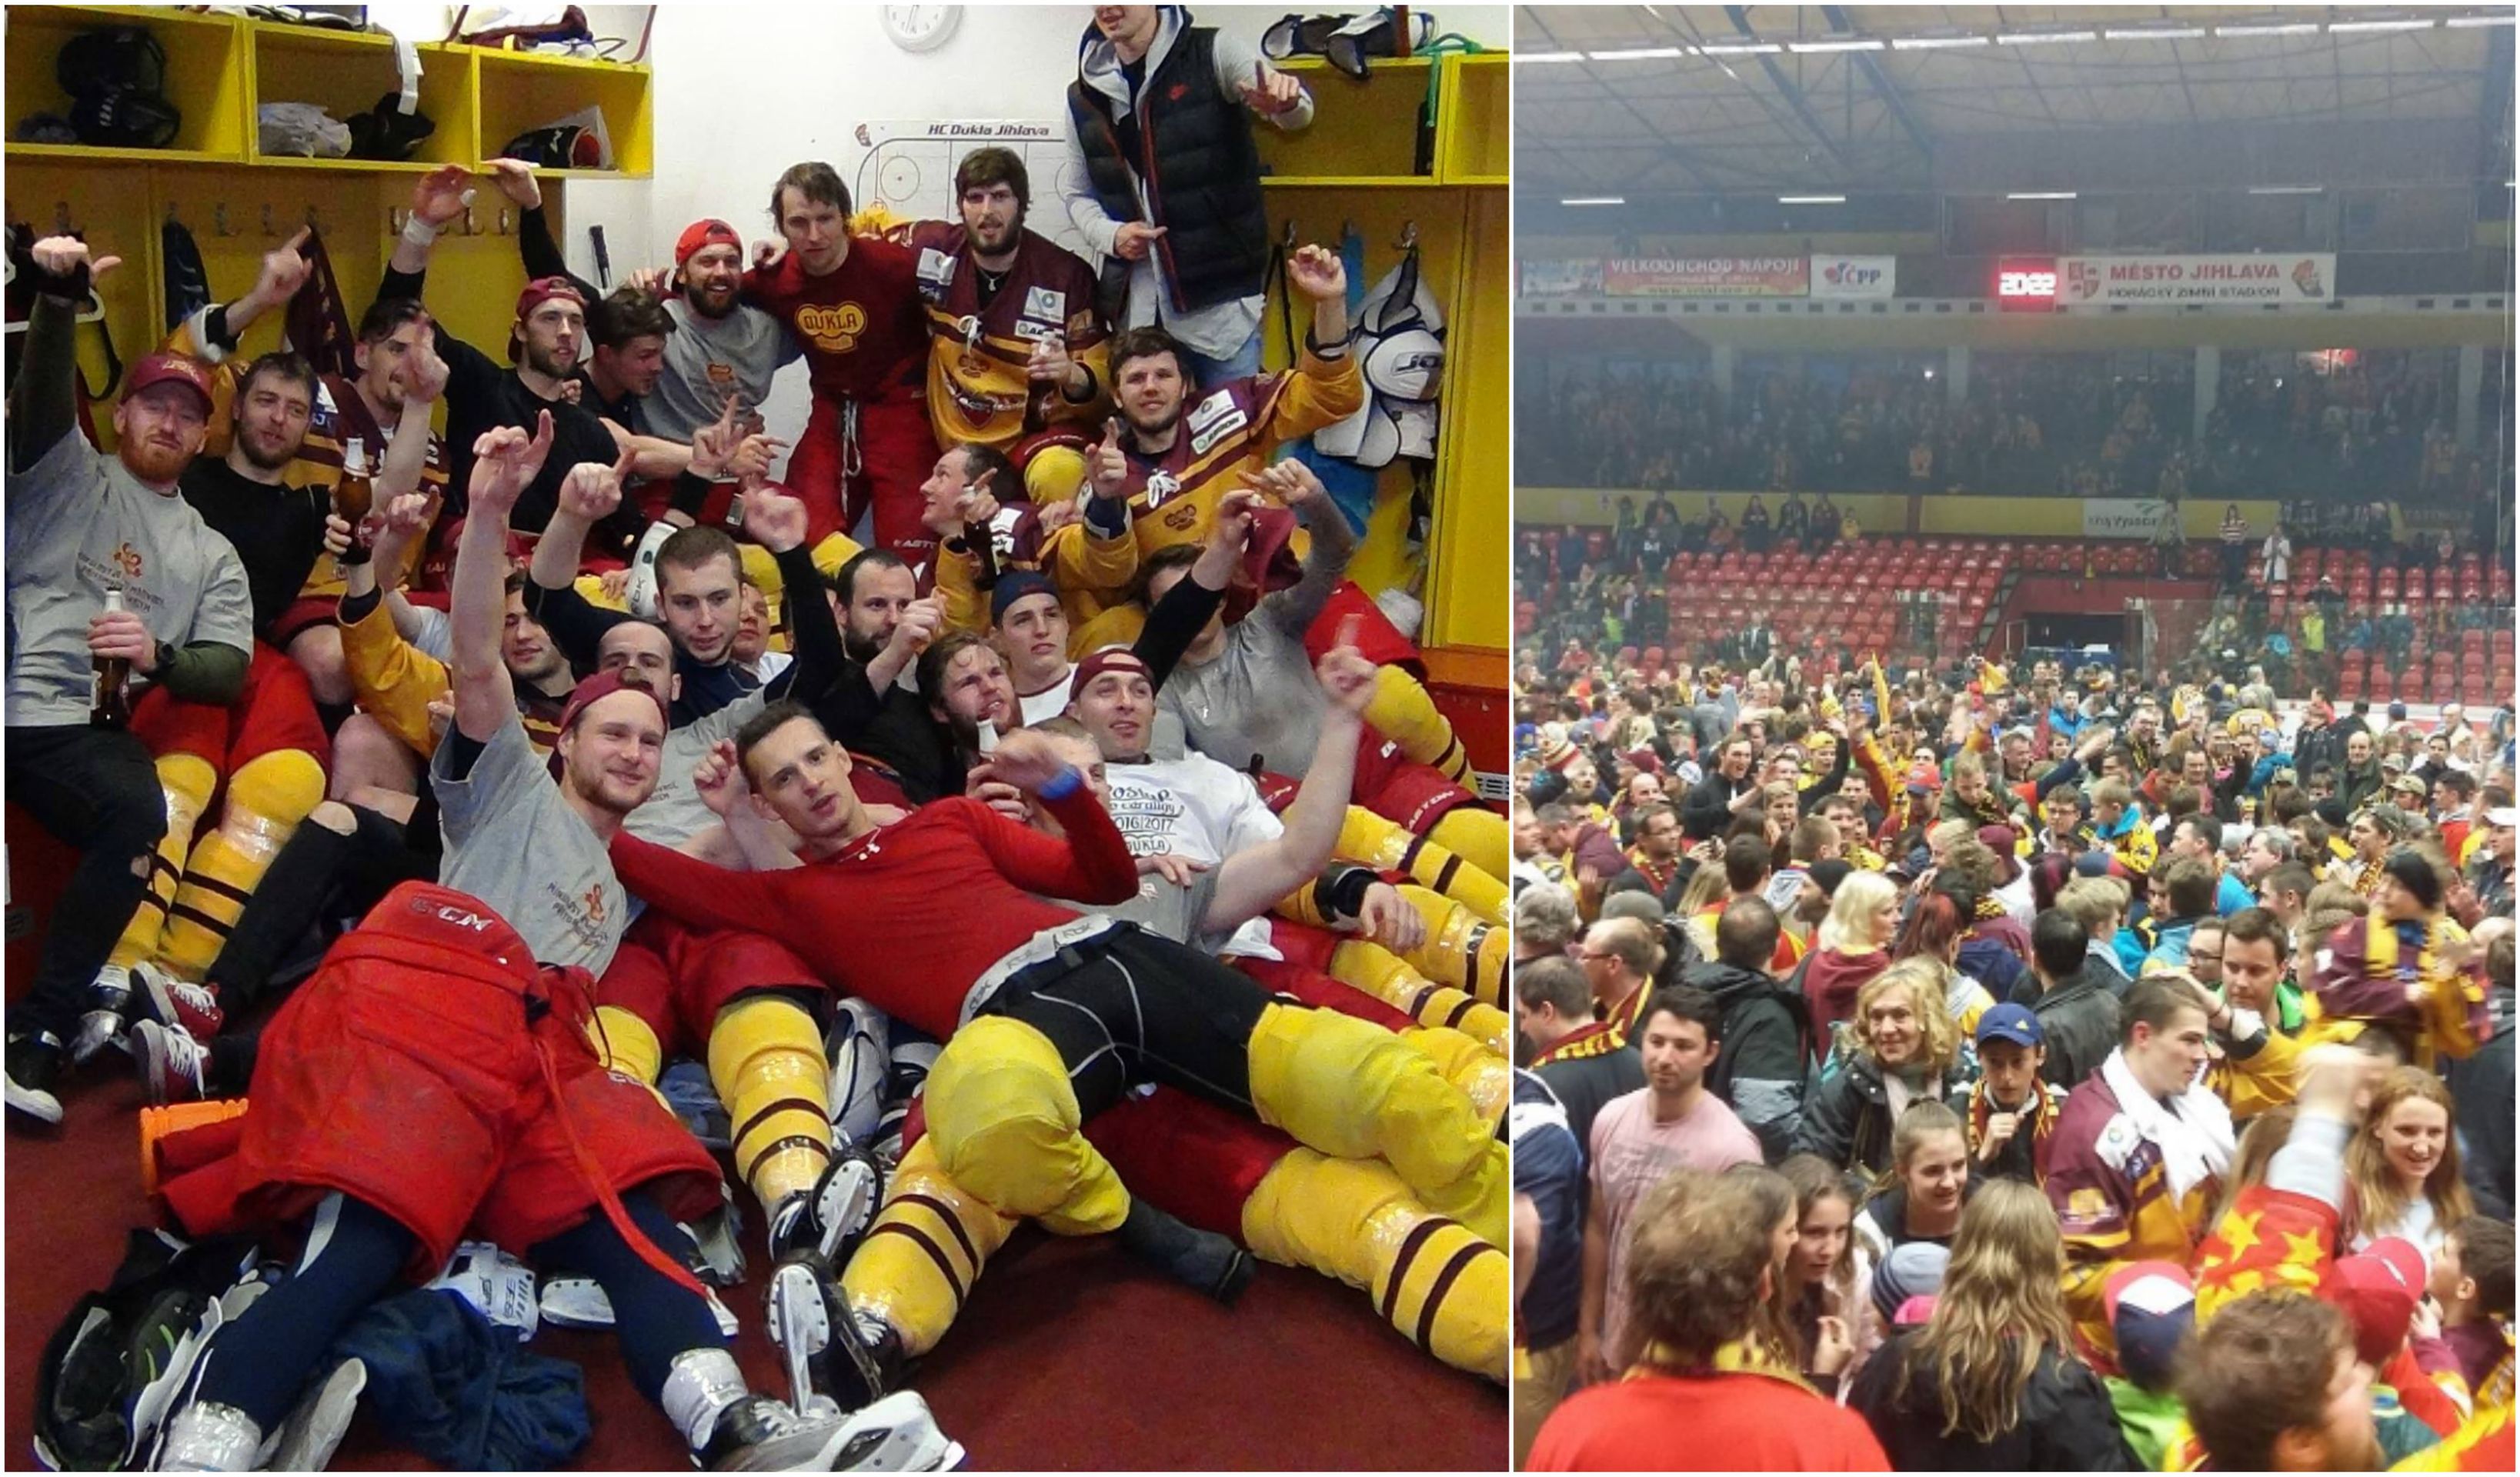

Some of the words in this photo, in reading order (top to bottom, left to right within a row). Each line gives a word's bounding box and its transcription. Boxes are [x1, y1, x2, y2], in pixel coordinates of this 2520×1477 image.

[928, 124, 949, 135] HC
[950, 124, 993, 135] Dukla
[995, 125, 1050, 136] Jihlava
[2191, 264, 2280, 280] JIHLAVA
[803, 312, 858, 329] DUKLA
